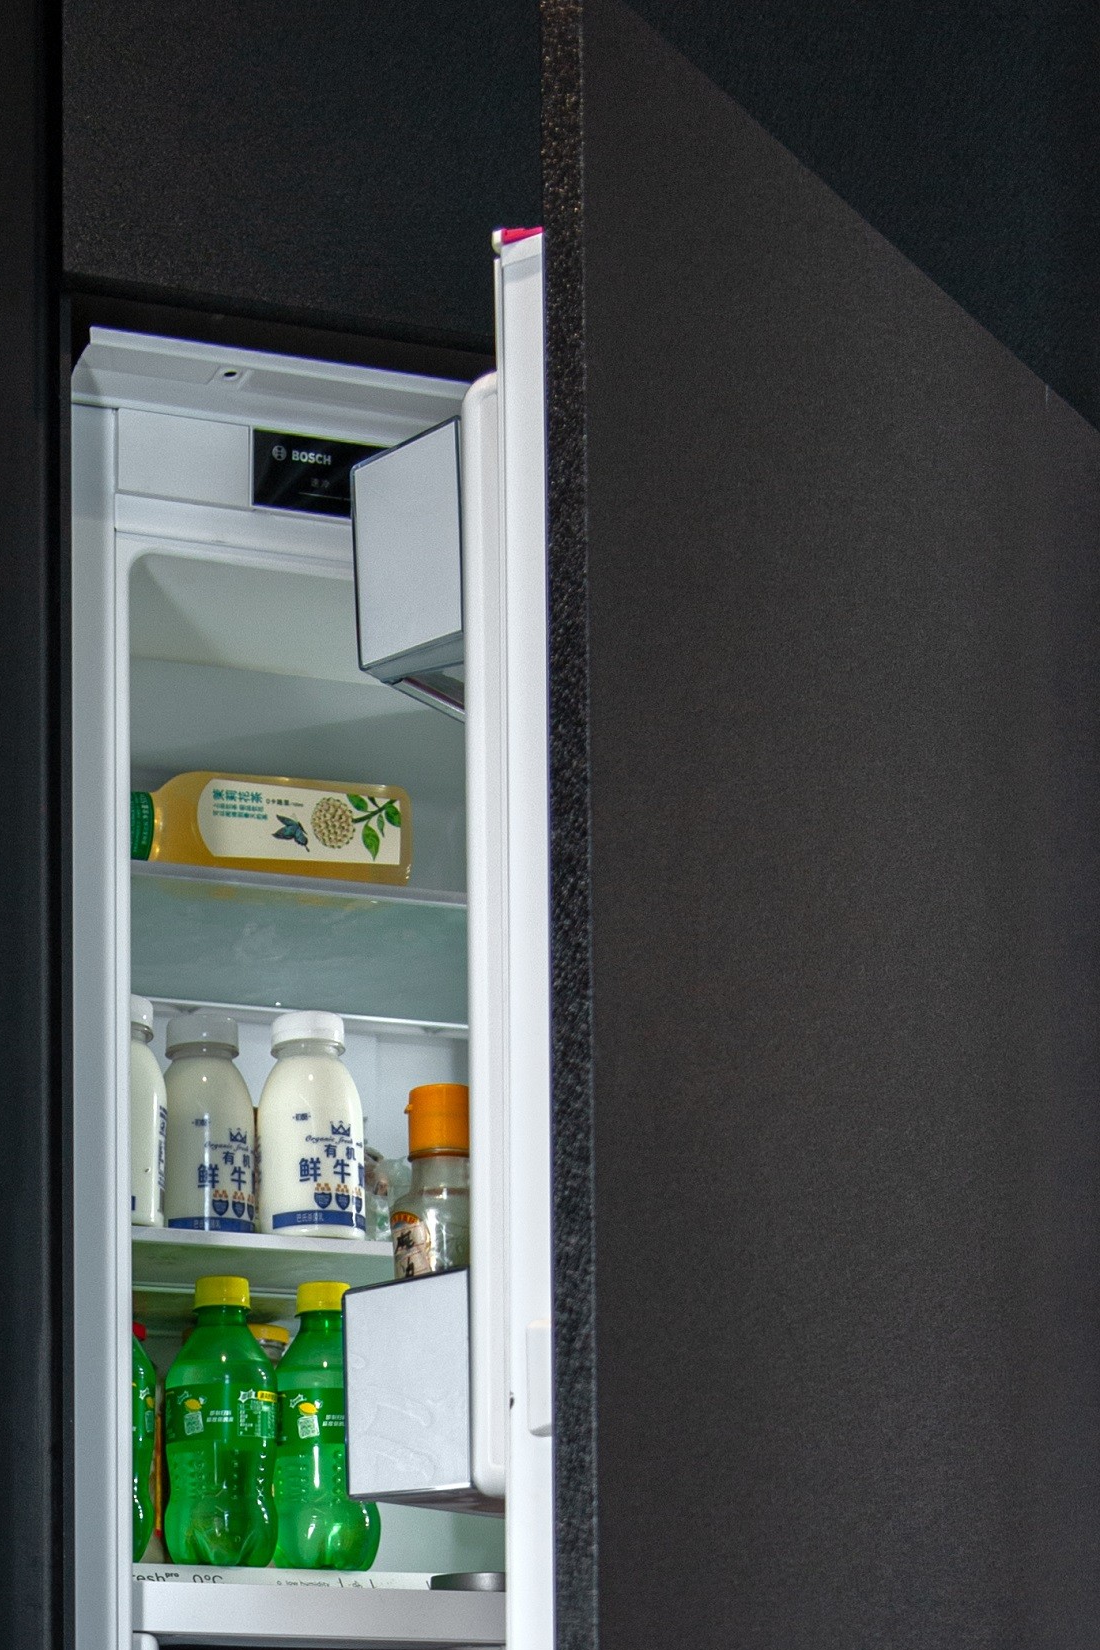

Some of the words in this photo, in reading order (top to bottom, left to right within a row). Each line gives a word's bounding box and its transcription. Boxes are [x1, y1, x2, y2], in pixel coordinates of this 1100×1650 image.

[291, 449, 332, 465] BOSCH
[305, 1134, 335, 1144] Organic
[222, 1150, 251, 1169] 有机
[324, 1144, 356, 1161] 有机
[197, 1163, 256, 1194] 鲜牛
